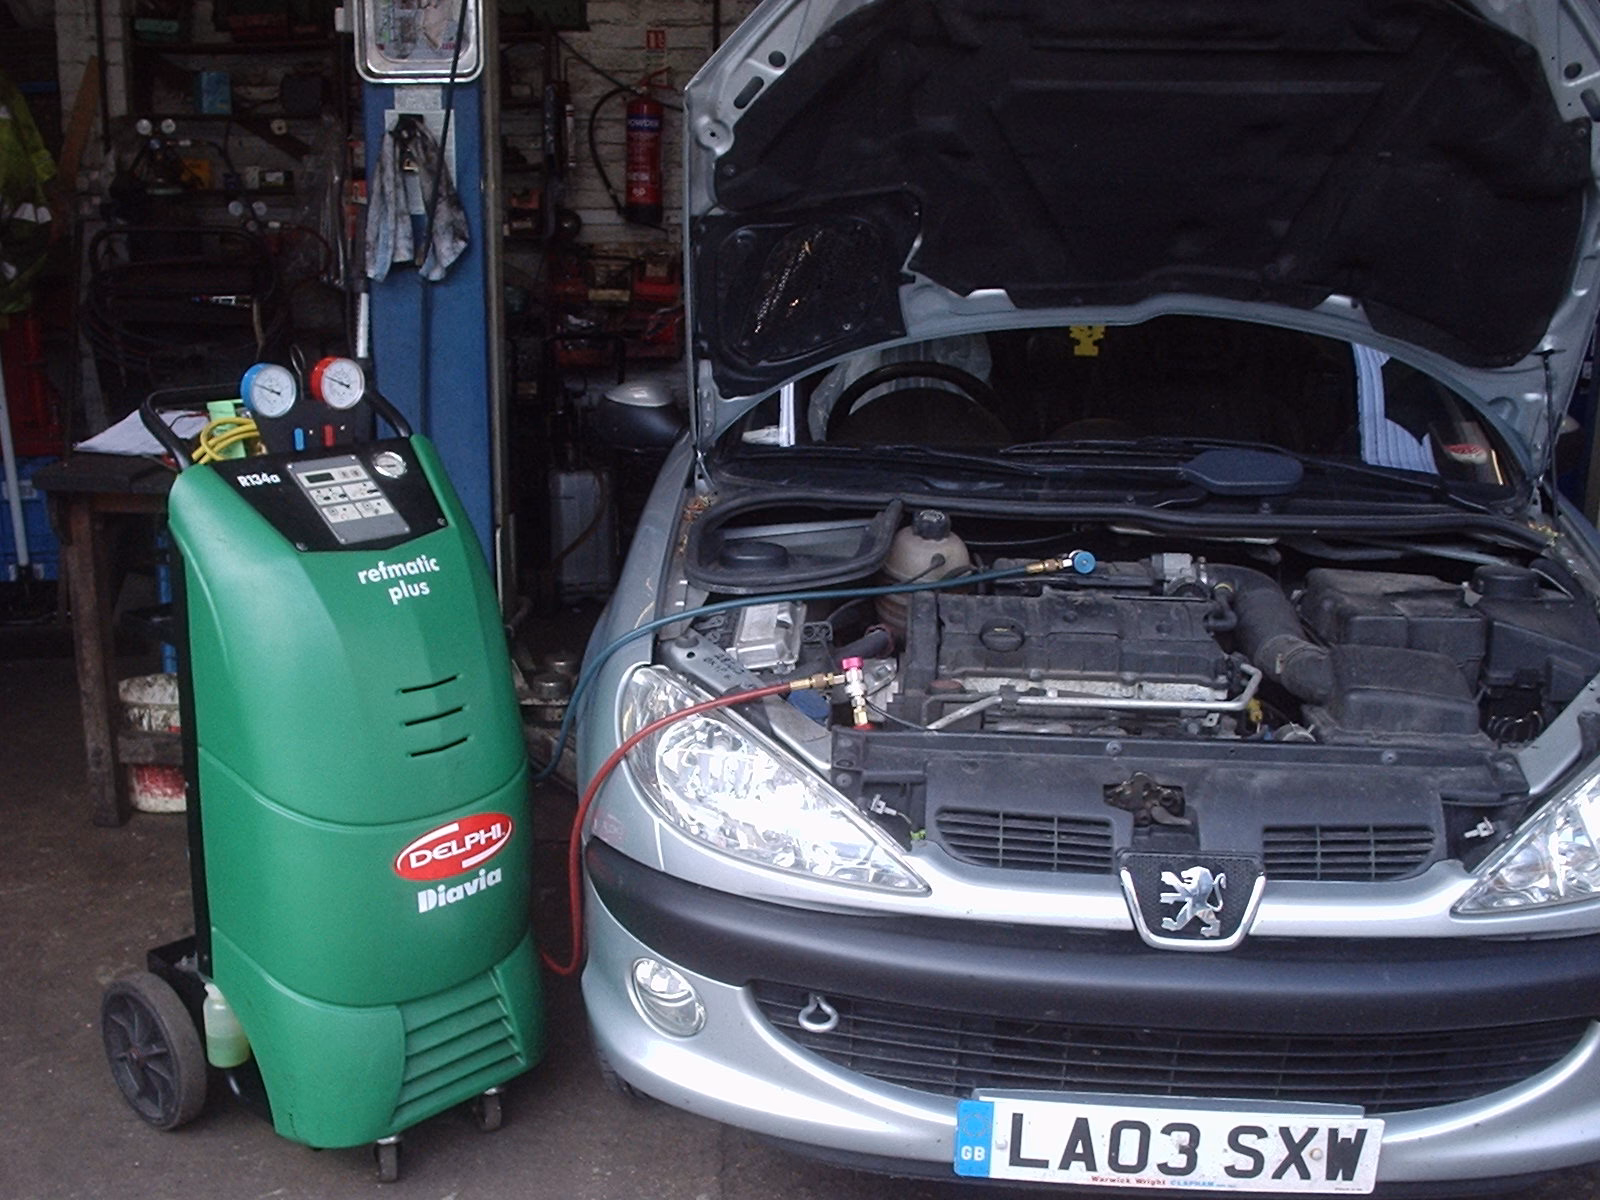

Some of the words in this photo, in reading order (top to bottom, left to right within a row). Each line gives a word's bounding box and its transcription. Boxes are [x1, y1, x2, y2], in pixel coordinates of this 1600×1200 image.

[236, 472, 281, 487] R134a
[358, 554, 440, 584] refmatic
[388, 580, 430, 605] plus
[408, 822, 502, 869] DELPHI
[417, 867, 502, 913] Diavia
[961, 1145, 986, 1161] GB
[1008, 1112, 1201, 1177] LA03
[1223, 1125, 1368, 1181] SXW
